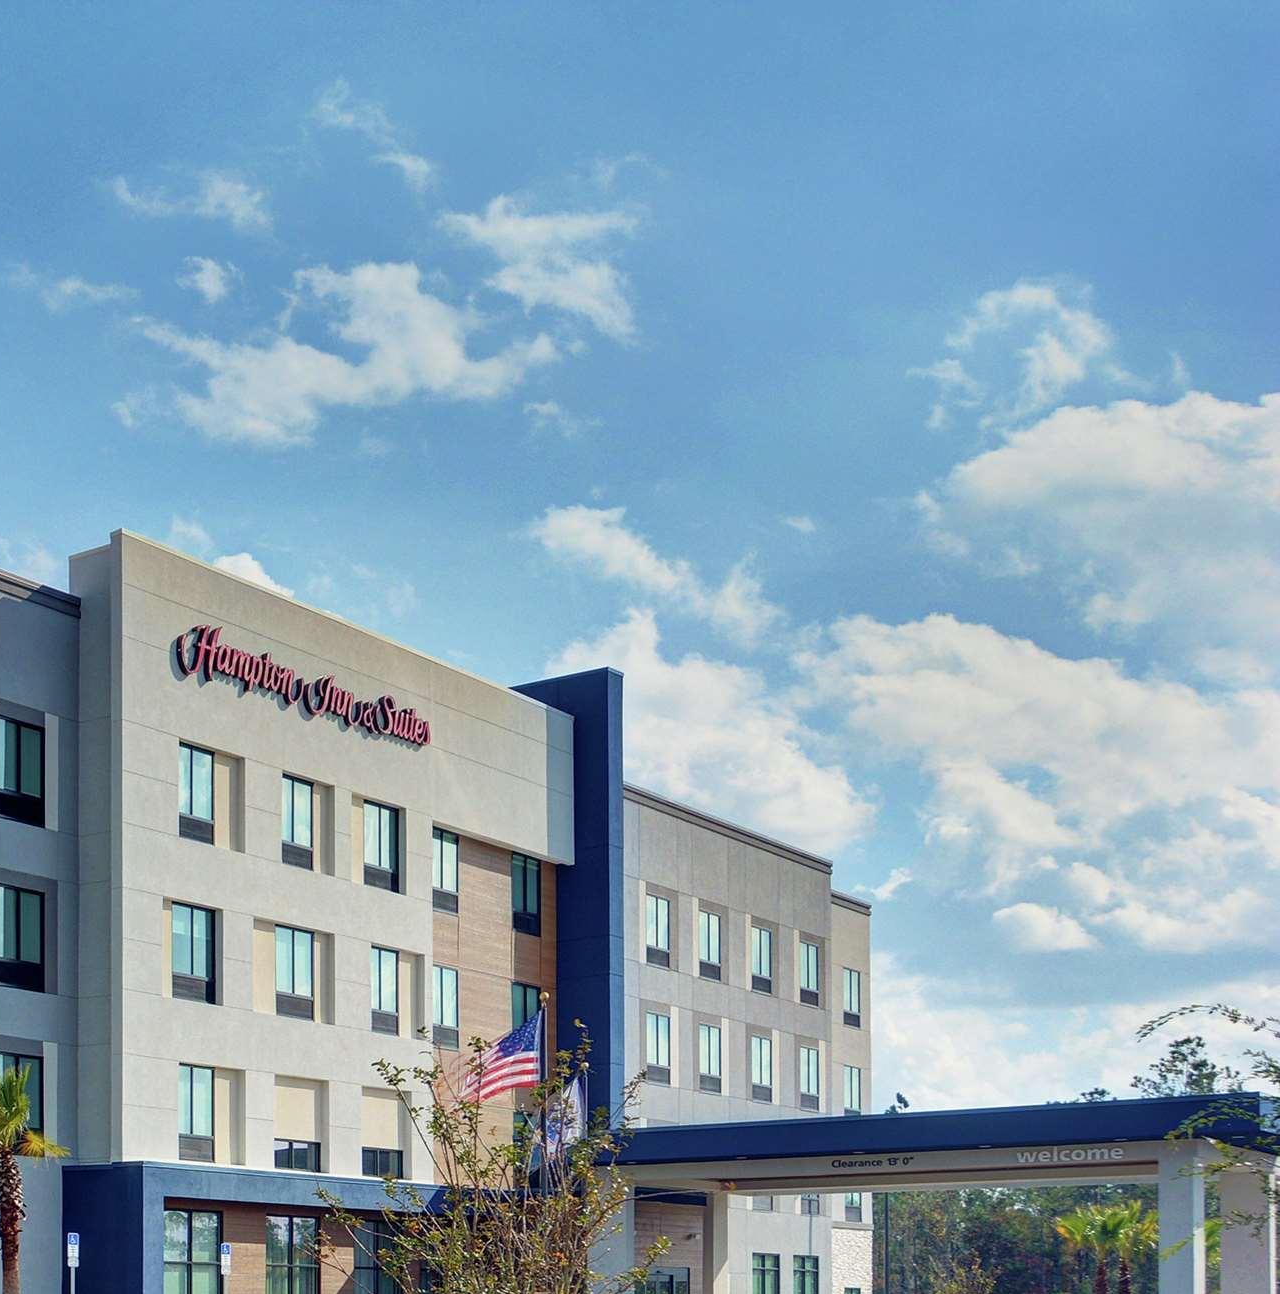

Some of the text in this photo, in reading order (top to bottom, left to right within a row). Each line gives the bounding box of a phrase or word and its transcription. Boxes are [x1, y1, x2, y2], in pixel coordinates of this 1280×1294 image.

[176, 624, 304, 704] Hampton
[304, 672, 363, 726] Inn
[371, 695, 432, 745] Suites
[1017, 1146, 1124, 1163] welcome
[831, 1159, 883, 1169] Clearance
